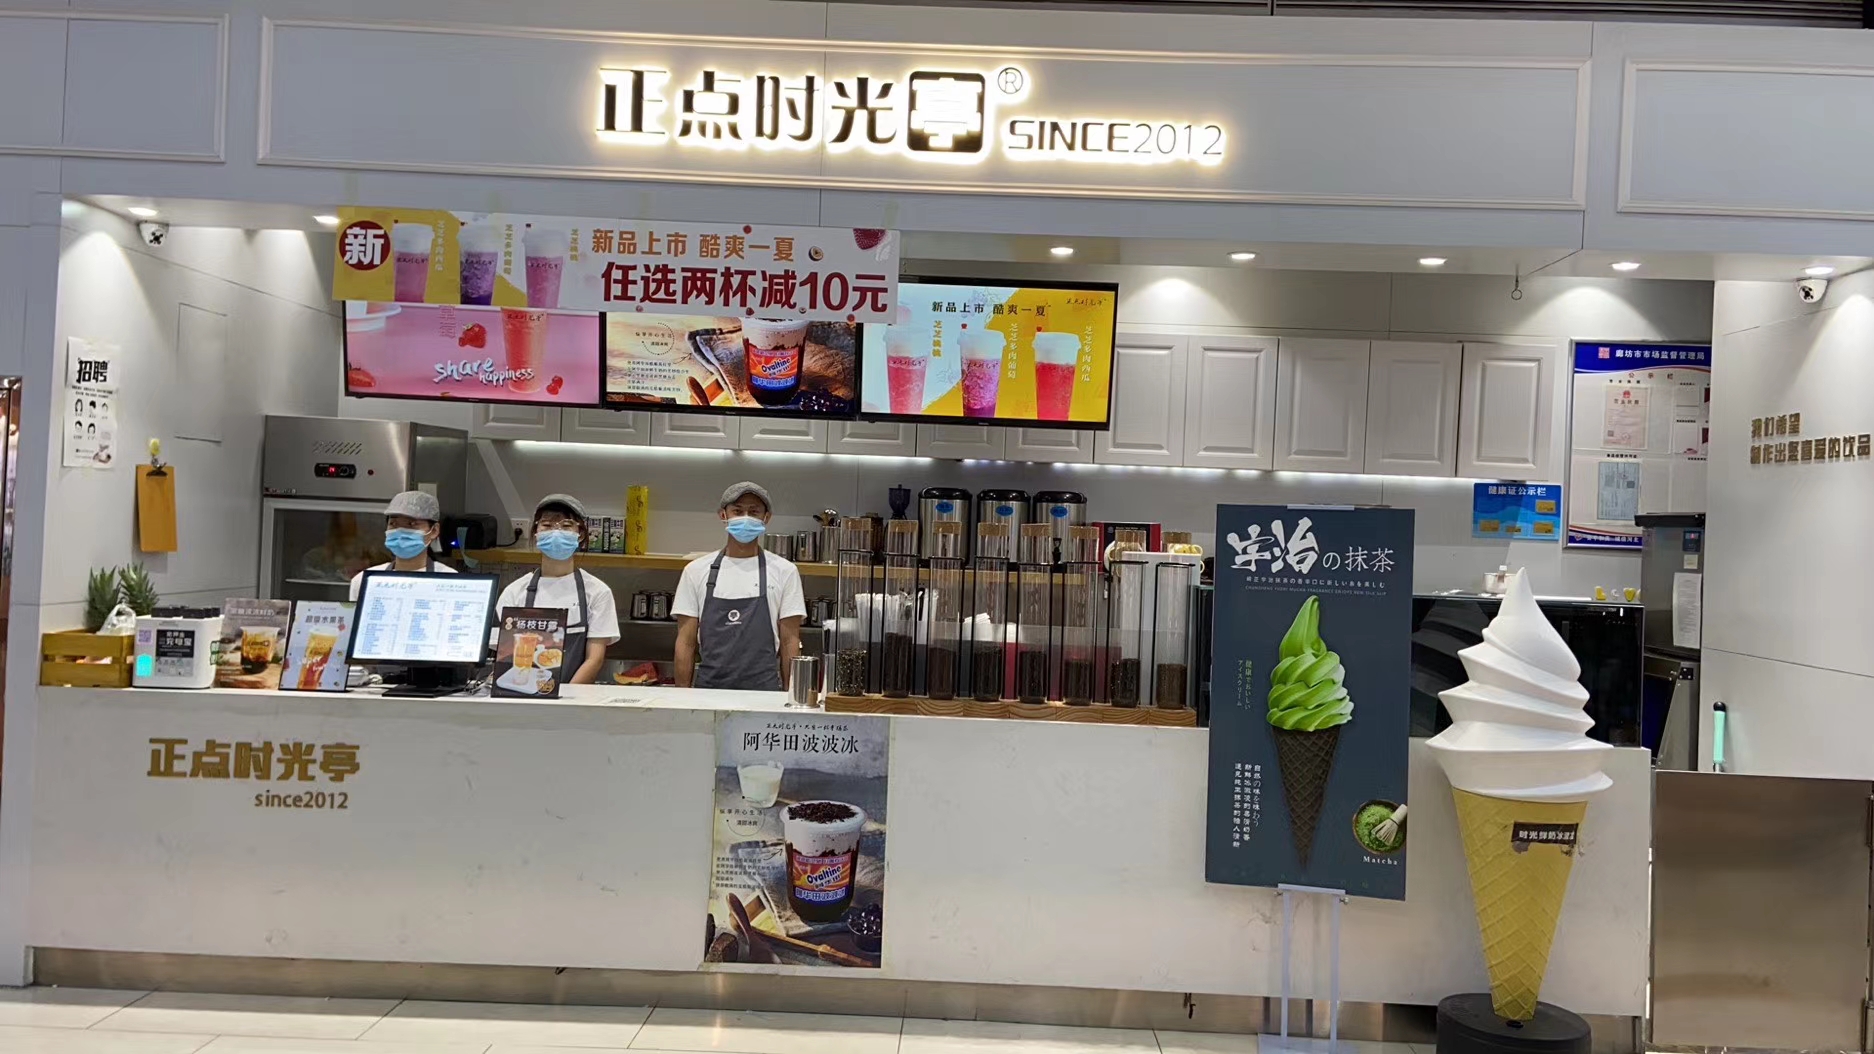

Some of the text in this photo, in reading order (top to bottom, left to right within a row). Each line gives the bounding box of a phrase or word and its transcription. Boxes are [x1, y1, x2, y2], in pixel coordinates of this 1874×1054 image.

[597, 68, 986, 153] 正点时光亭
[1007, 119, 1224, 157] SINCE2012
[344, 227, 385, 266] 新
[592, 228, 795, 262] 新品上市 酷爽一夏
[601, 261, 889, 313] 任选两杯减10元
[932, 301, 1046, 317] 新品上市 酷爽一夏
[761, 356, 791, 373] Ovaltine
[1615, 349, 1705, 360] 廊坊市市场监督管理局
[76, 359, 108, 384] 招聘
[432, 357, 495, 383] share
[479, 366, 535, 387] happiness
[1751, 412, 1801, 439] 我们希望
[1750, 434, 1871, 464] 制作出您喜爱的饮品
[1488, 485, 1547, 497] 健康证公示栏
[1226, 516, 1396, 574] 宇治の抹茶
[516, 620, 558, 630] 杨枝甘露
[743, 732, 859, 754] 阿华田波波冰
[147, 738, 360, 782] 正点时光亭
[254, 790, 348, 809] since2012
[1362, 855, 1398, 866] Matcha
[806, 865, 842, 884] Ovaltine
